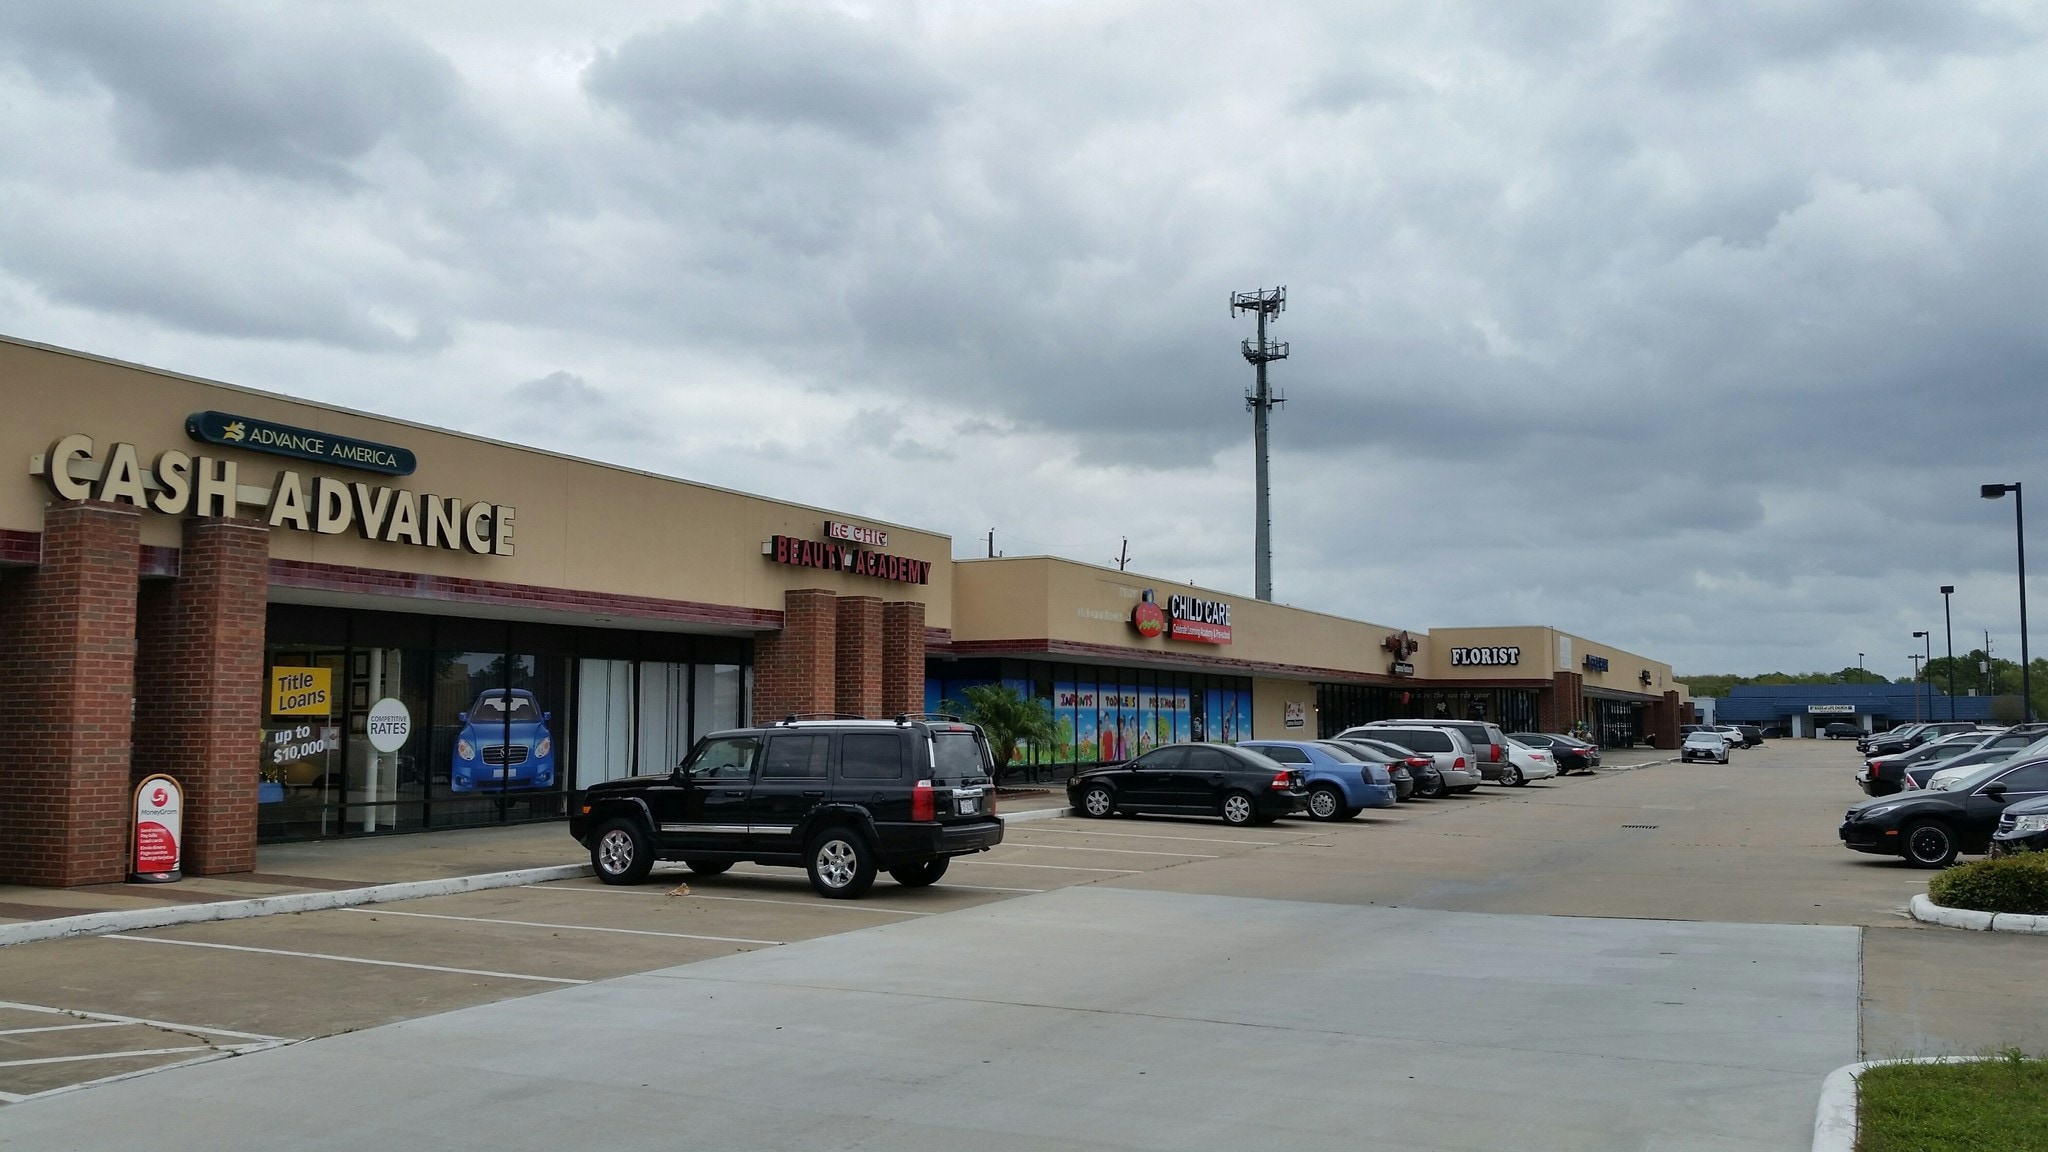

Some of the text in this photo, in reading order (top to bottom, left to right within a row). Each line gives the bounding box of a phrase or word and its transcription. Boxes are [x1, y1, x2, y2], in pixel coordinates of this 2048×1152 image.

[249, 428, 397, 467] ADVANCE AMERICA
[47, 434, 515, 556] CASH ADVANCE
[830, 522, 888, 546] LE CHIC
[776, 535, 931, 585] BEAUTY ACADEMY
[1171, 594, 1231, 627] CHILD CARE
[1451, 647, 1519, 665] FLORIST
[278, 672, 314, 693] Title
[279, 689, 326, 711] Loans
[1105, 695, 1136, 707] TODLERS
[370, 715, 407, 723] COMPETITIVE
[370, 722, 407, 735] RATES
[275, 725, 311, 744] up to
[273, 739, 325, 764] $10,000
